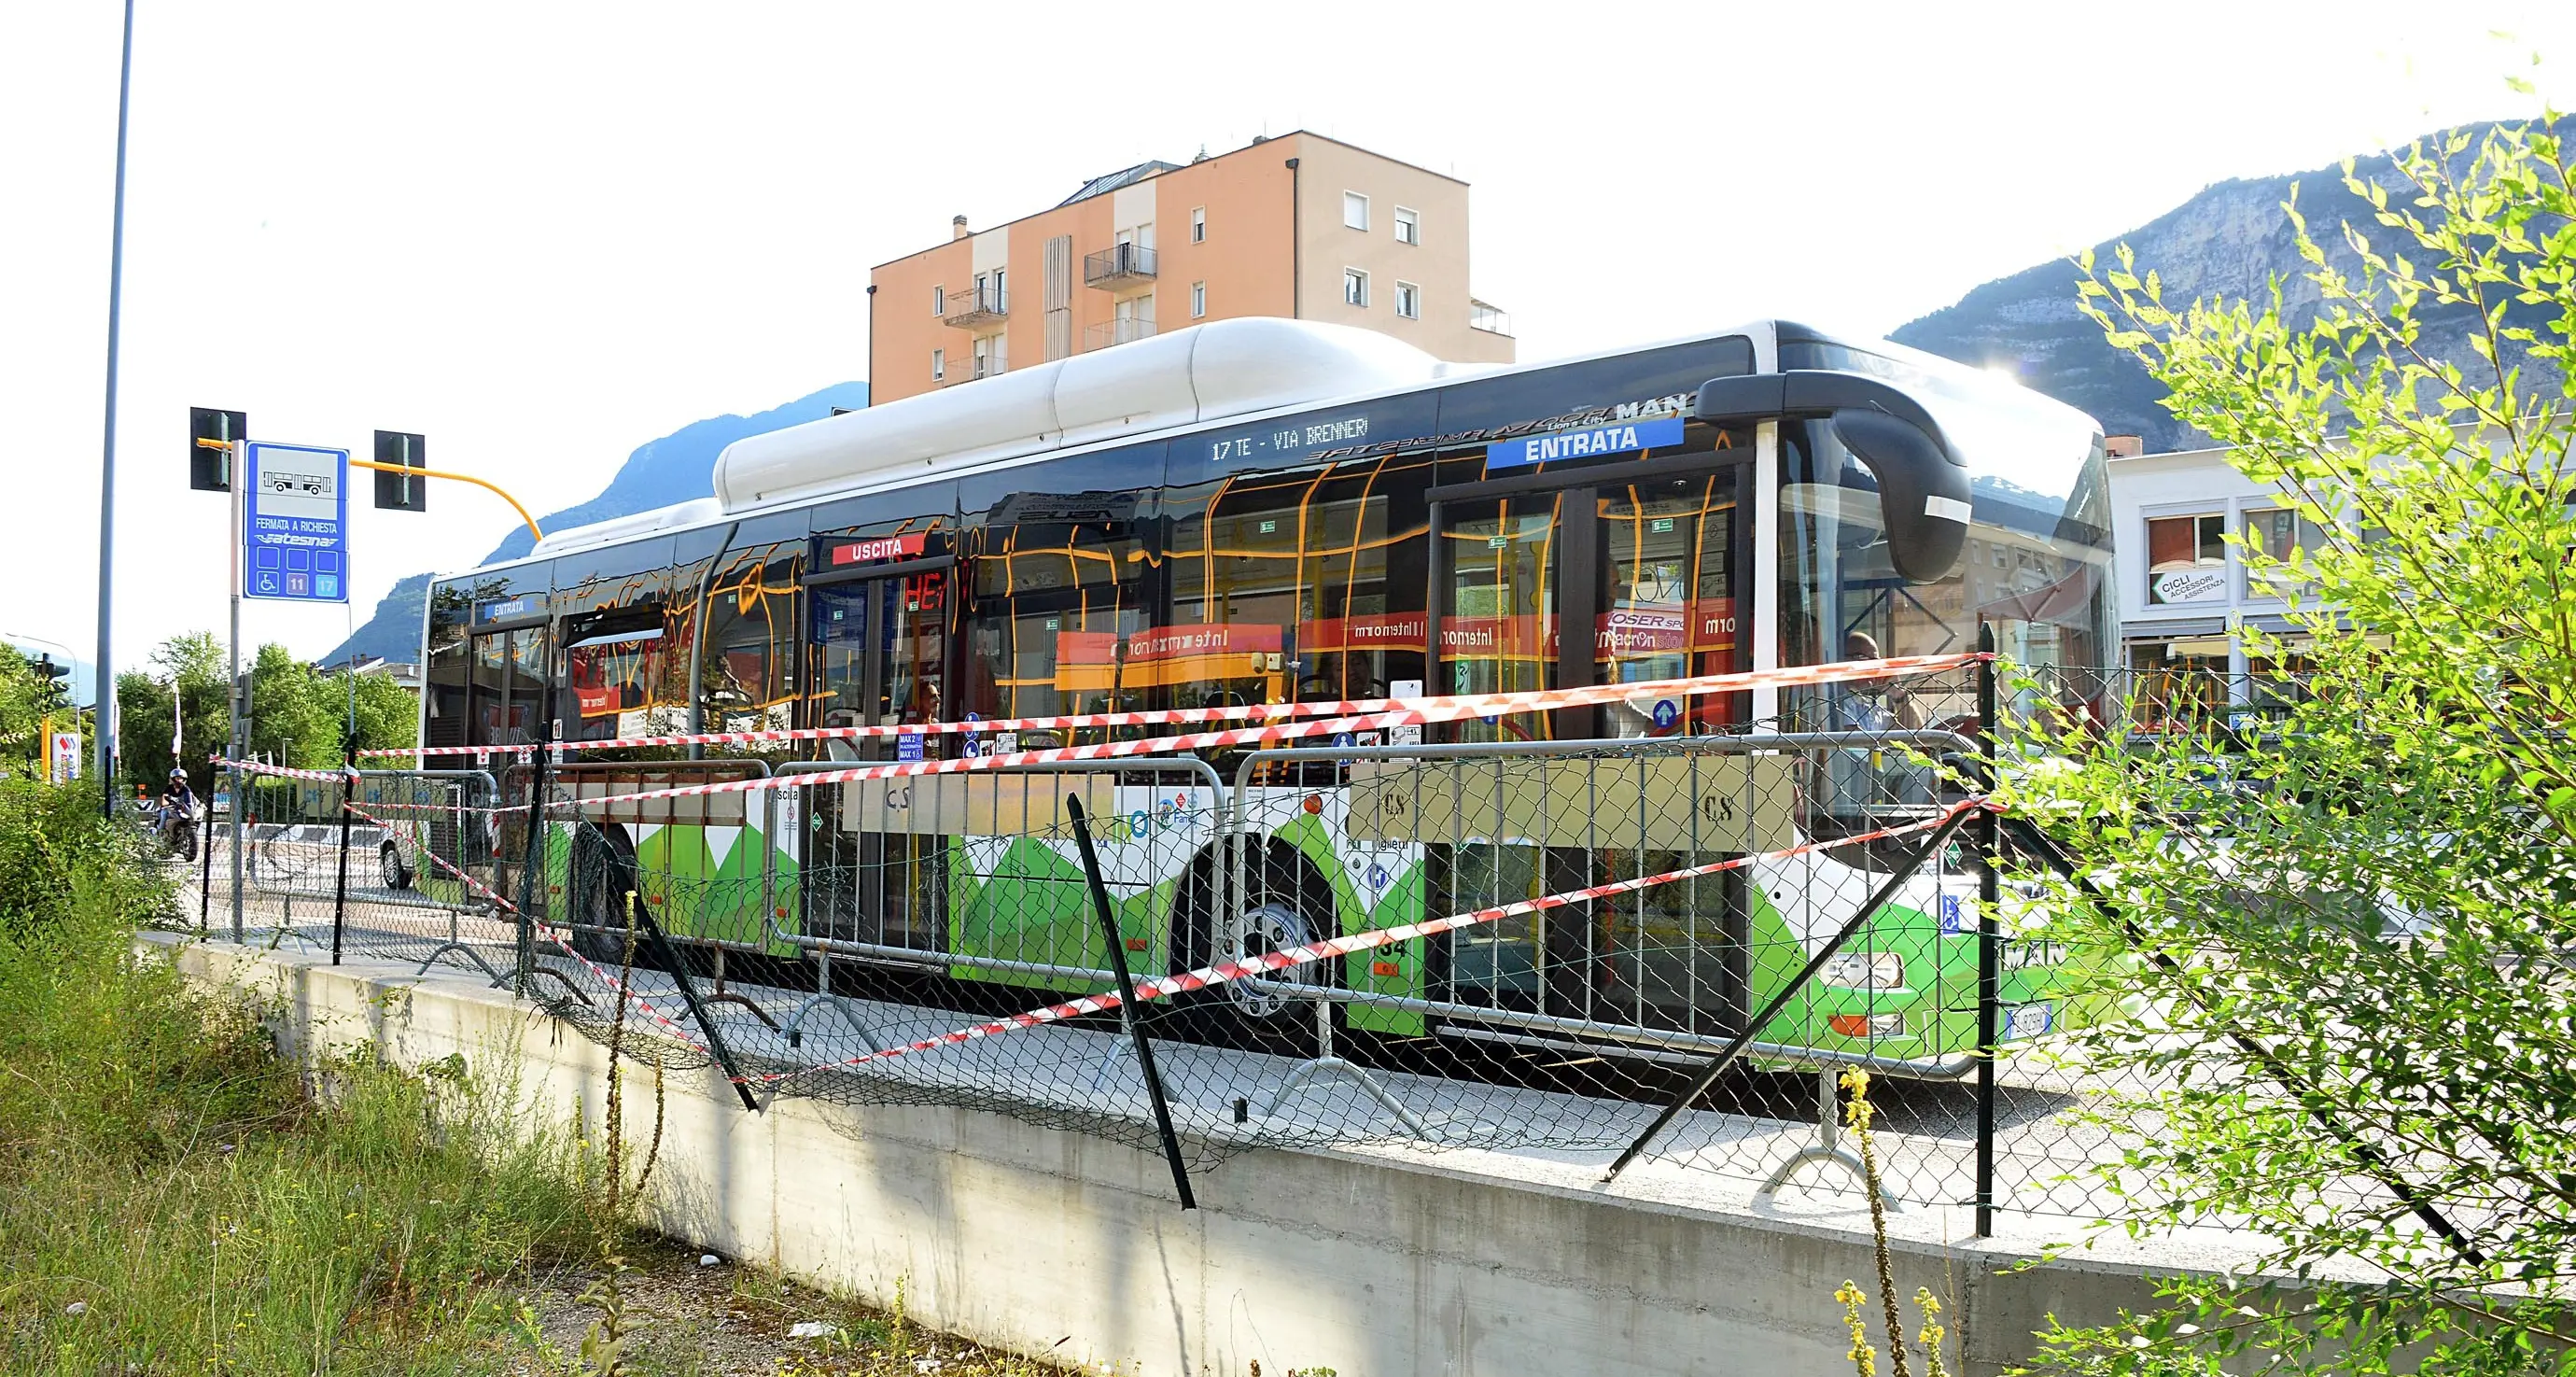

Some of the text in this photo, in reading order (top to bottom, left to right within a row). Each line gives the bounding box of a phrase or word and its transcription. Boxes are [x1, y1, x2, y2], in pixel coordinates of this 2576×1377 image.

[1617, 395, 1687, 420] MAN
[1213, 442, 1231, 460] 17
[1236, 438, 1252, 457] TE
[1274, 430, 1298, 450] VIA
[1526, 427, 1638, 462] ENTRATA
[256, 517, 337, 533] FERMATA A RICHIESTA
[852, 540, 903, 560] USCITA
[290, 578, 303, 590] 11
[320, 580, 334, 592] 17
[2162, 575, 2191, 593] CICLI
[2171, 575, 2214, 597] ACCESSORI
[2184, 579, 2225, 600] ASSISTENZA
[494, 599, 525, 616] ENTRATA
[1608, 613, 1664, 626] OSER
[900, 735, 911, 743] MAX
[900, 750, 911, 758] MAX
[2004, 942, 2066, 972] MAN
